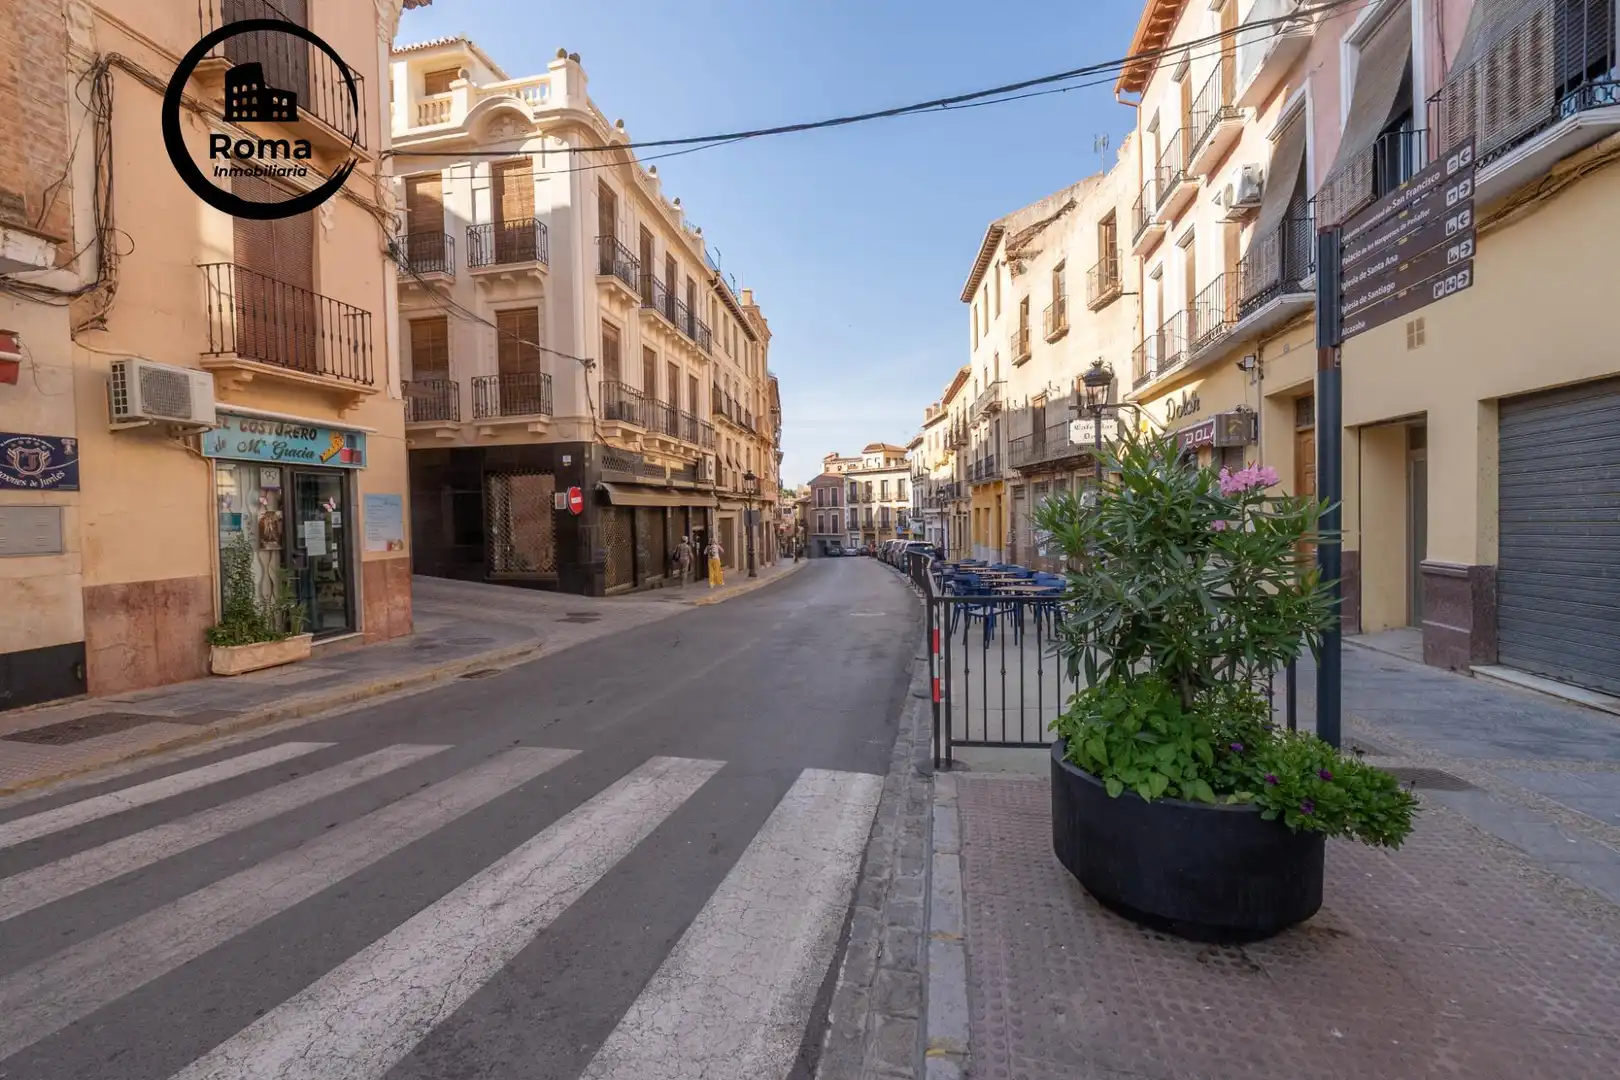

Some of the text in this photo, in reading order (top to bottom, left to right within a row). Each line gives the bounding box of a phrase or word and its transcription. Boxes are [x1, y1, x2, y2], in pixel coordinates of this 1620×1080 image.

[1385, 204, 1391, 213] de
[1393, 195, 1404, 208] San
[1406, 171, 1439, 198] Francisco
[1342, 249, 1361, 265] Palacio
[1341, 254, 1398, 291] Iglesia de Santa Ana
[1341, 282, 1395, 315] Iglesia de Santiago
[1341, 321, 1365, 336] Alcazaba
[240, 419, 318, 441] COSTURERO
[269, 440, 316, 461] Gracia
